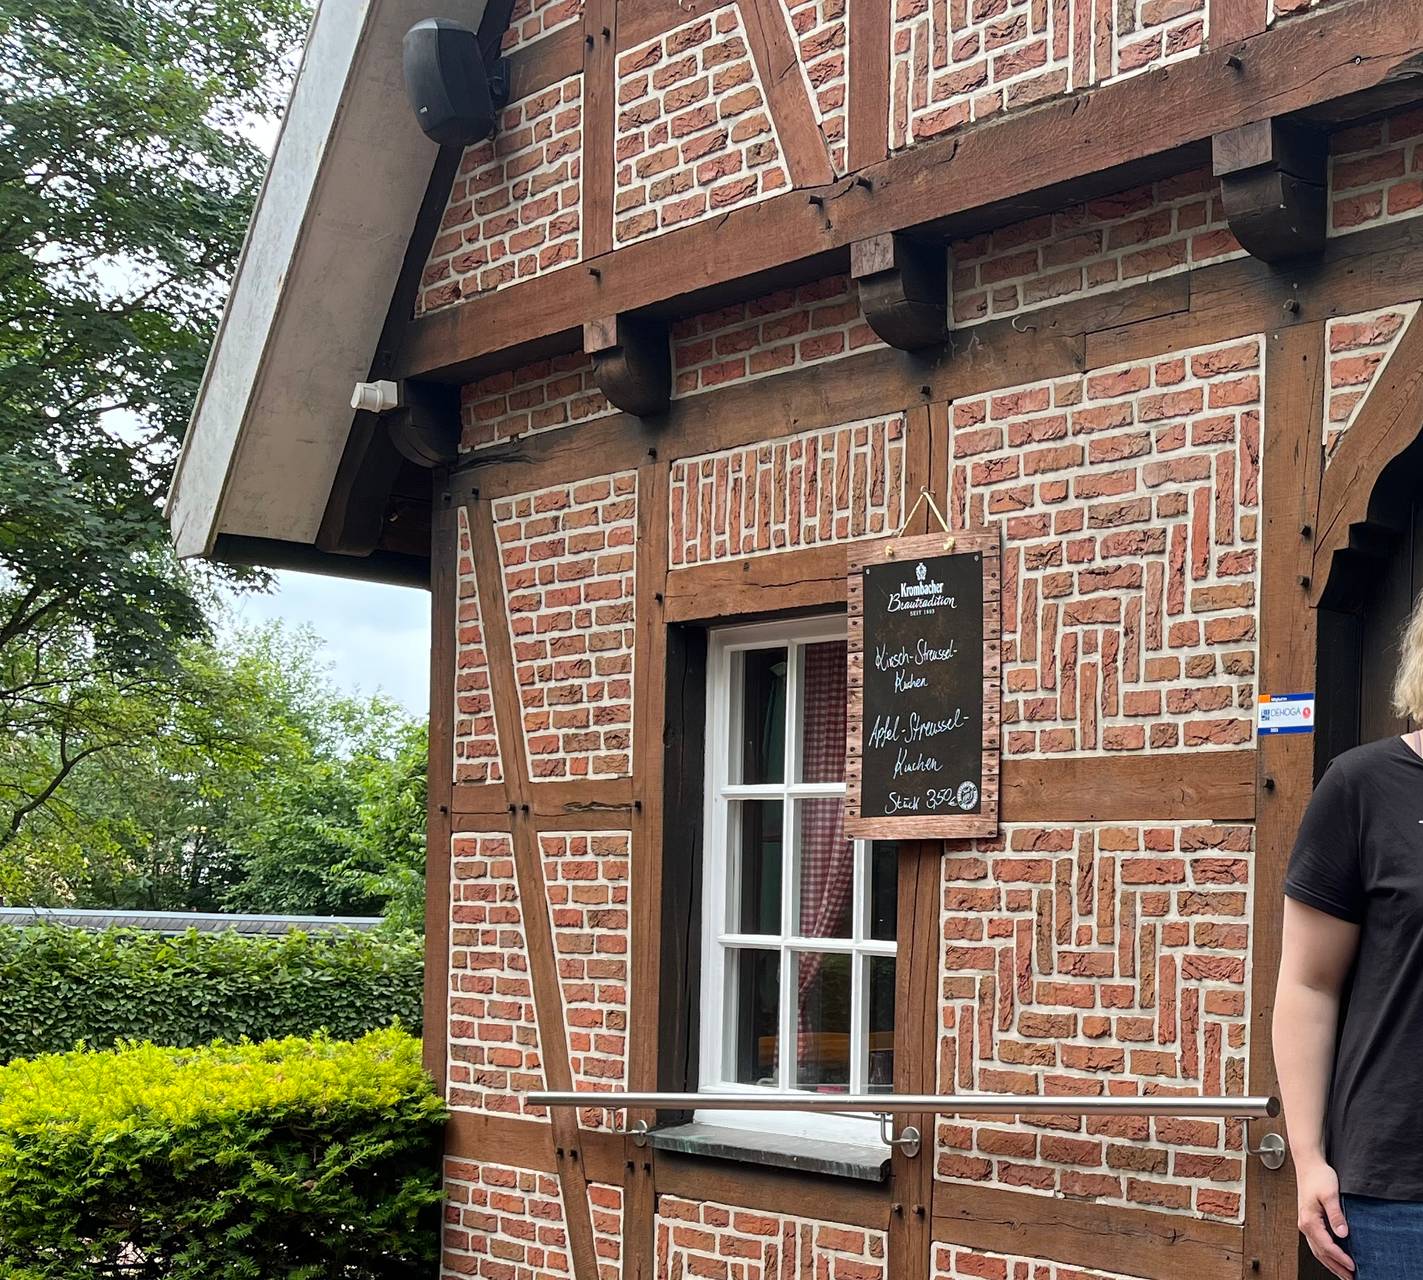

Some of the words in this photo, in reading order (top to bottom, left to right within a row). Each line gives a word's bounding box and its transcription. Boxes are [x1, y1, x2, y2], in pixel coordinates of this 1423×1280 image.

[900, 579, 944, 597] Krombacher
[887, 593, 957, 612] Brautradition
[895, 669, 929, 694] Kuchen
[1270, 706, 1301, 717] DEHOGA
[893, 747, 944, 780] Kuchen
[884, 792, 920, 814] Stück
